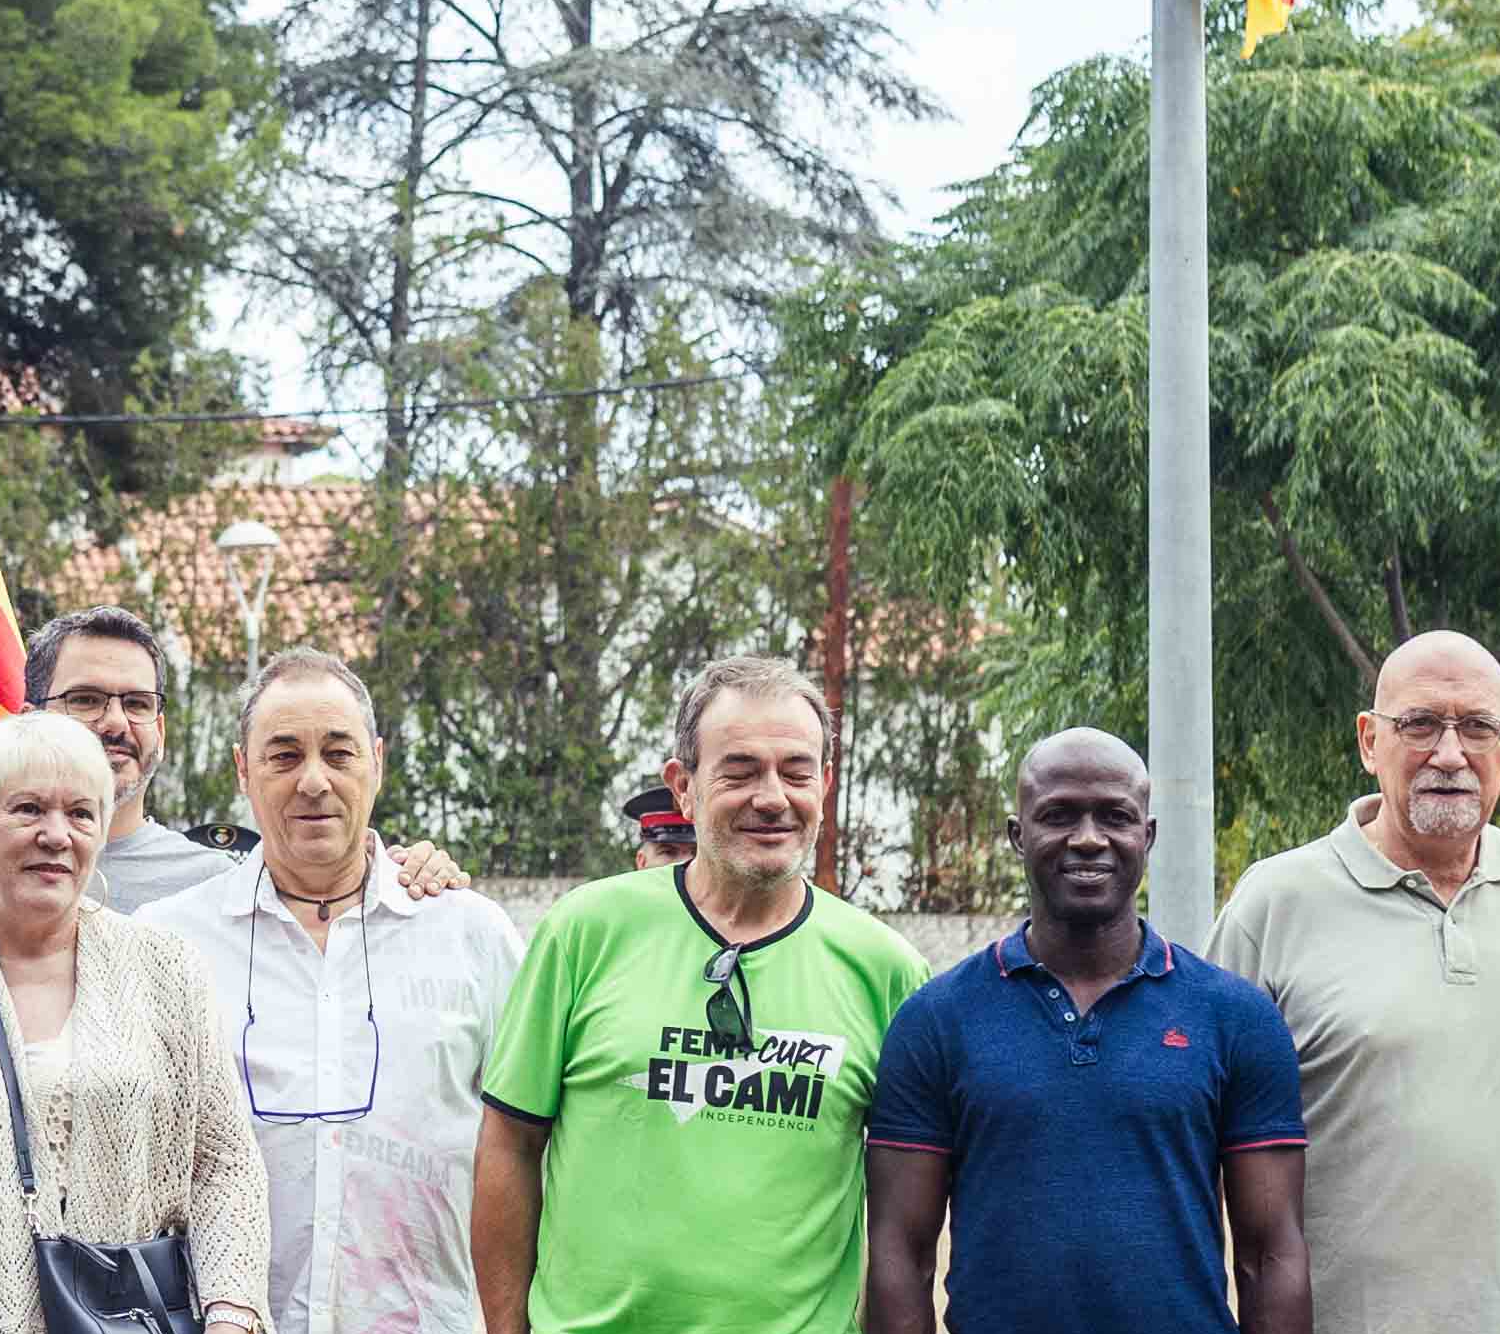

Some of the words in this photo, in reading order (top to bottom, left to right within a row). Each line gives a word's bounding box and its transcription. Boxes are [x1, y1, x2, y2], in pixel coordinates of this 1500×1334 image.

[758, 1035, 832, 1072] CURT
[648, 1057, 694, 1104] EL
[704, 1065, 826, 1120] CAMÍ
